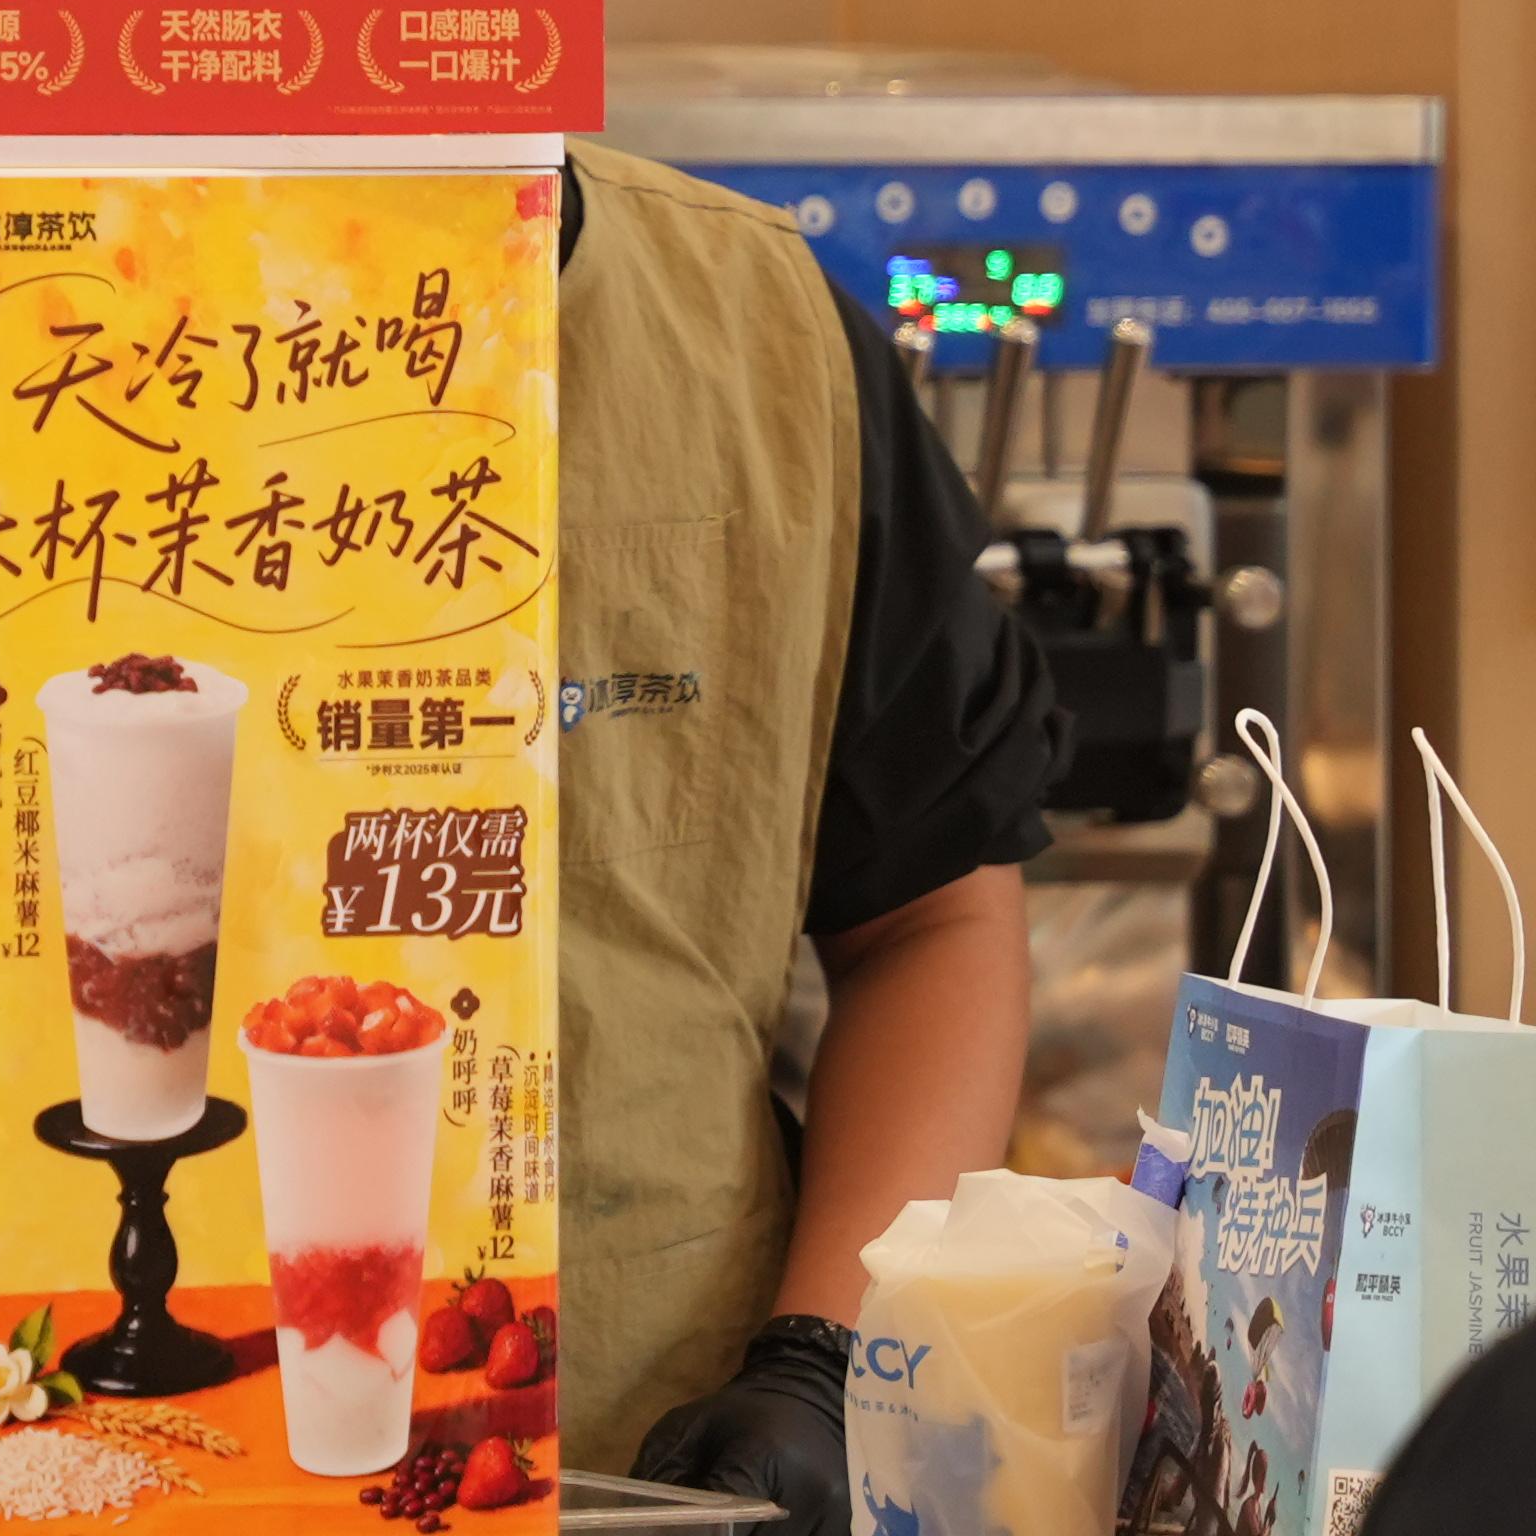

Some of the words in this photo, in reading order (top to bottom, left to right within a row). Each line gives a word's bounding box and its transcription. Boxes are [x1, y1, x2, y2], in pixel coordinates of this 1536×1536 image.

[160, 9, 282, 44] 天然肠衣
[400, 9, 520, 44] 口感脆弹
[160, 49, 282, 84] 干净配料
[400, 49, 520, 84] 一口爆汁
[14, 267, 462, 452] 天冷了就喝
[338, 668, 491, 689] 水果茉香奶茶品类
[316, 697, 515, 751] 销量第一
[14, 749, 40, 928] 红豆椰米麻薯
[344, 811, 523, 861] 两杯仅需
[326, 861, 523, 935] ¥13元
[1, 933, 40, 958] ¥12
[452, 1028, 477, 1114] 奶呼呼
[489, 1056, 514, 1231] 草莓茉香麻薯
[524, 1066, 540, 1204] 沉淀时间味道
[477, 1235, 515, 1260] ¥12
[1218, 1172, 1328, 1277] 特种兵
[1383, 1226, 1405, 1237] BCCY
[1469, 1212, 1483, 1266] FRUIT
[1496, 1212, 1530, 1329] 水果茉
[1469, 1271, 1484, 1354] JASMINE
